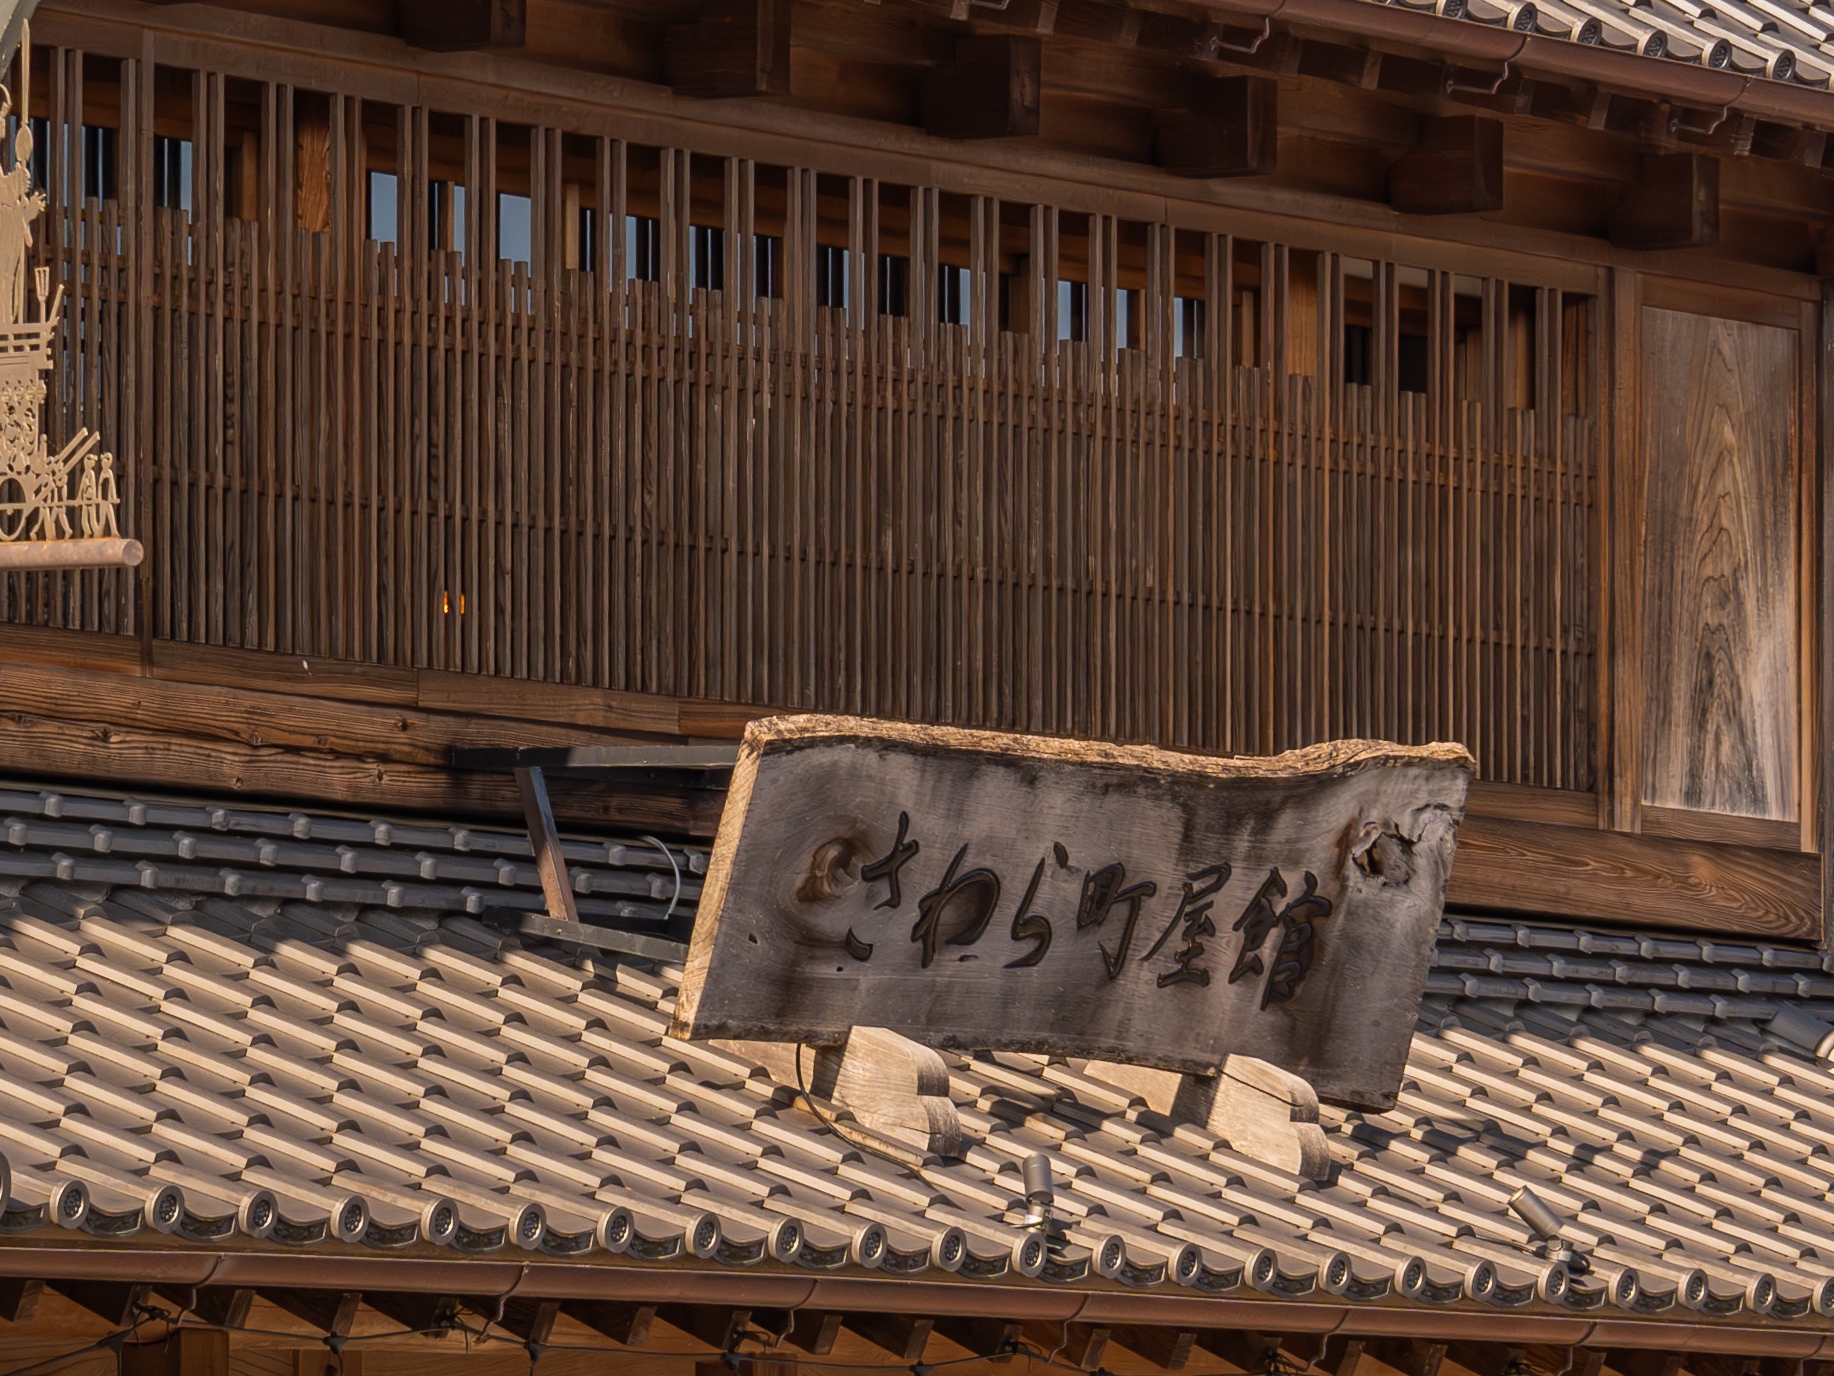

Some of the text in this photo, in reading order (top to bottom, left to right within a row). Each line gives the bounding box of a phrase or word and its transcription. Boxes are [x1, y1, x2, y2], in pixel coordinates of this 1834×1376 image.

[845, 810, 1333, 1013] さわら町屋館
